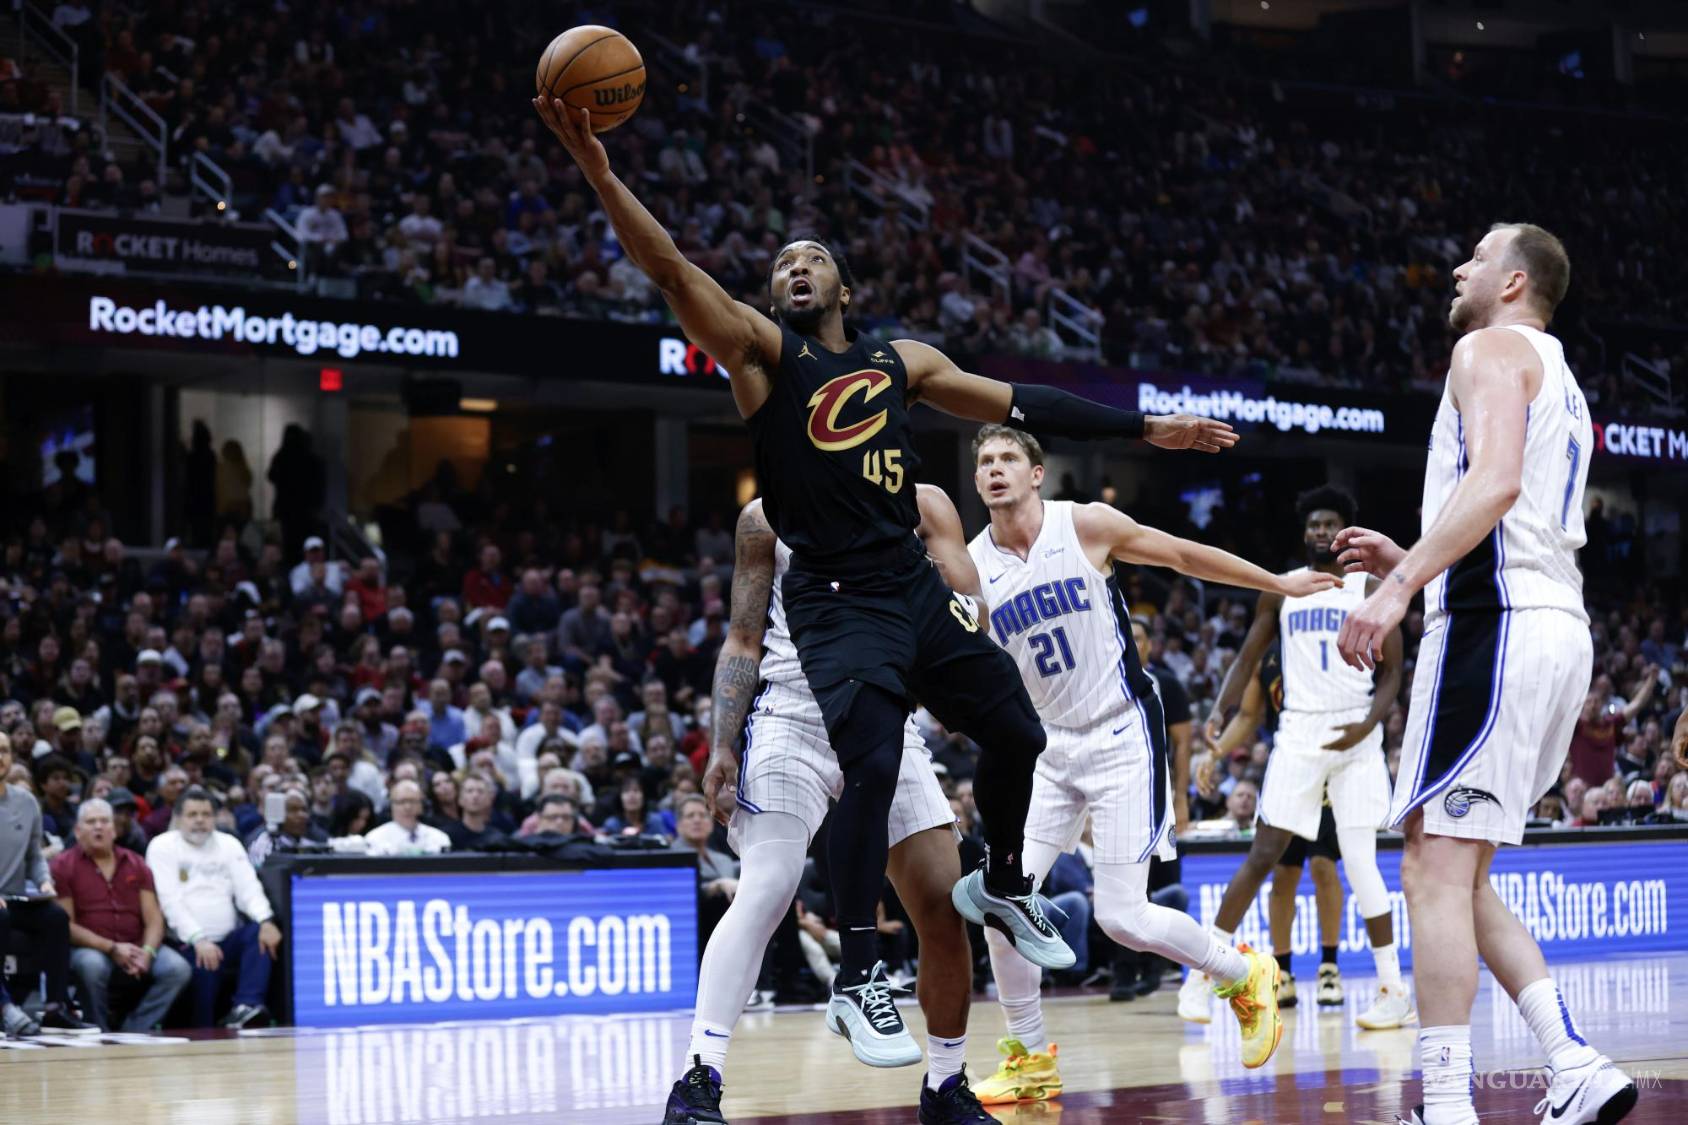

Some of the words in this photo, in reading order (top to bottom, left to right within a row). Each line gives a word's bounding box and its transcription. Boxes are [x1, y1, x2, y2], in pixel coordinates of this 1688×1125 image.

[76, 230, 178, 259] ROCKET
[181, 240, 259, 266] Homes
[90, 296, 459, 357] RocketMortgage.com
[1137, 383, 1385, 433] RocketMortgage.com
[1668, 428, 1688, 460] M
[862, 449, 904, 494] 45
[990, 577, 1091, 647] MAGIC
[1028, 626, 1076, 678] 21
[1319, 639, 1328, 671] 1
[322, 899, 672, 1006] NBAStore.com
